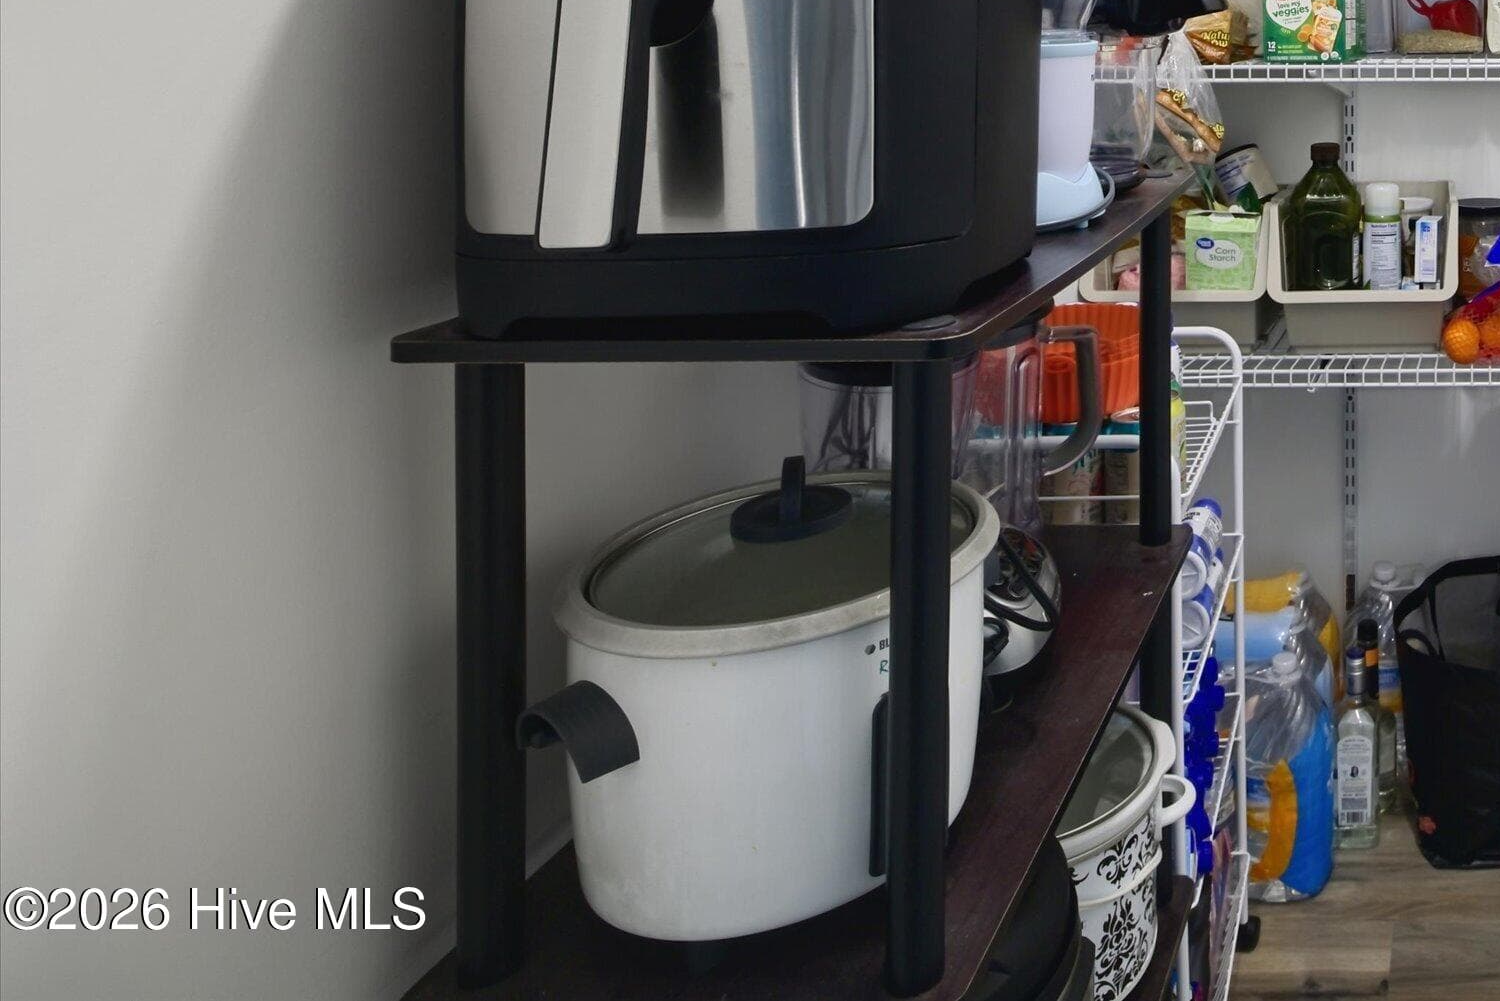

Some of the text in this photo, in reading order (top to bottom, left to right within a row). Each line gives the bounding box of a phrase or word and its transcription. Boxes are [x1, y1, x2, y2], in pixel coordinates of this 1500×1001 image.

[1272, 5, 1309, 18] veggies
[1200, 30, 1229, 40] Natu
[1267, 41, 1276, 49] 12
[1215, 247, 1236, 255] Corn
[1208, 254, 1236, 262] Starch
